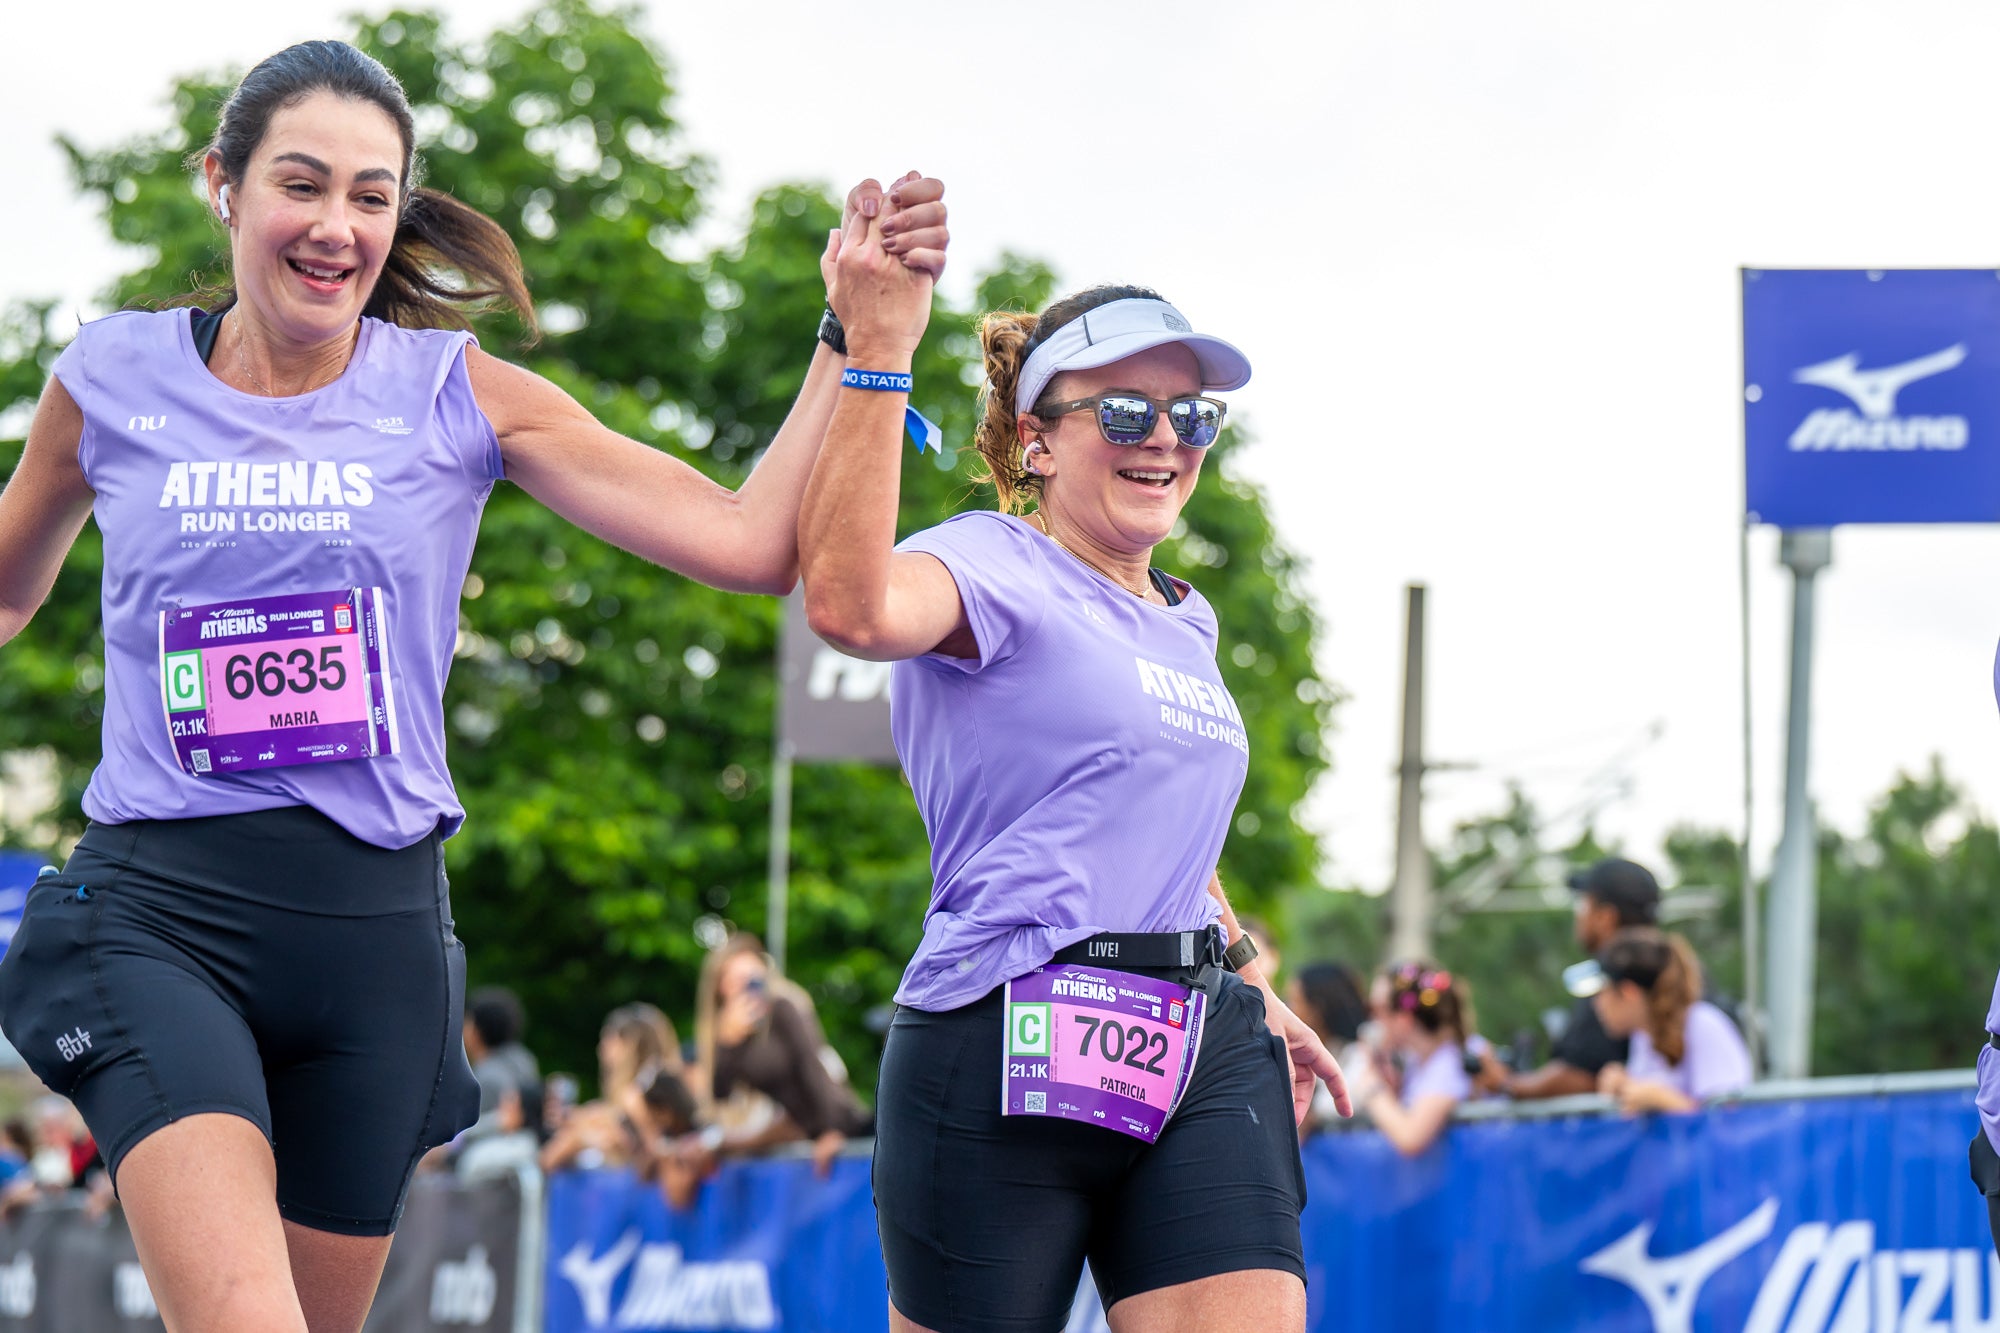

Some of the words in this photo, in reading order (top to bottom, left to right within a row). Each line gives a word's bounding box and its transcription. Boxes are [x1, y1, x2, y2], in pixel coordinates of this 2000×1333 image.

[158, 460, 374, 508] ATHENAS
[180, 512, 236, 532] RUN
[243, 511, 351, 532] LONGER
[181, 541, 200, 549] São
[200, 614, 268, 640] ATHENAS
[269, 612, 289, 622] RUN
[289, 609, 324, 620] LONGER
[173, 663, 195, 699] C
[225, 645, 347, 700] 6635
[172, 717, 207, 738] 21.1K
[269, 710, 320, 729] MARIA
[1160, 703, 1193, 733] RUN
[1197, 716, 1249, 757] LONGE
[1088, 941, 1119, 958] LIVE!
[1051, 978, 1117, 1003] ATHENAS
[1118, 988, 1134, 998] RUN
[1135, 991, 1162, 1005] LONGER
[56, 1026, 90, 1052] ALL
[1018, 1013, 1041, 1045] C
[63, 1034, 93, 1062] OUT
[1074, 1014, 1169, 1078] 7022
[1009, 1063, 1048, 1079] 21.1K
[1100, 1076, 1146, 1102] PATRICIA
